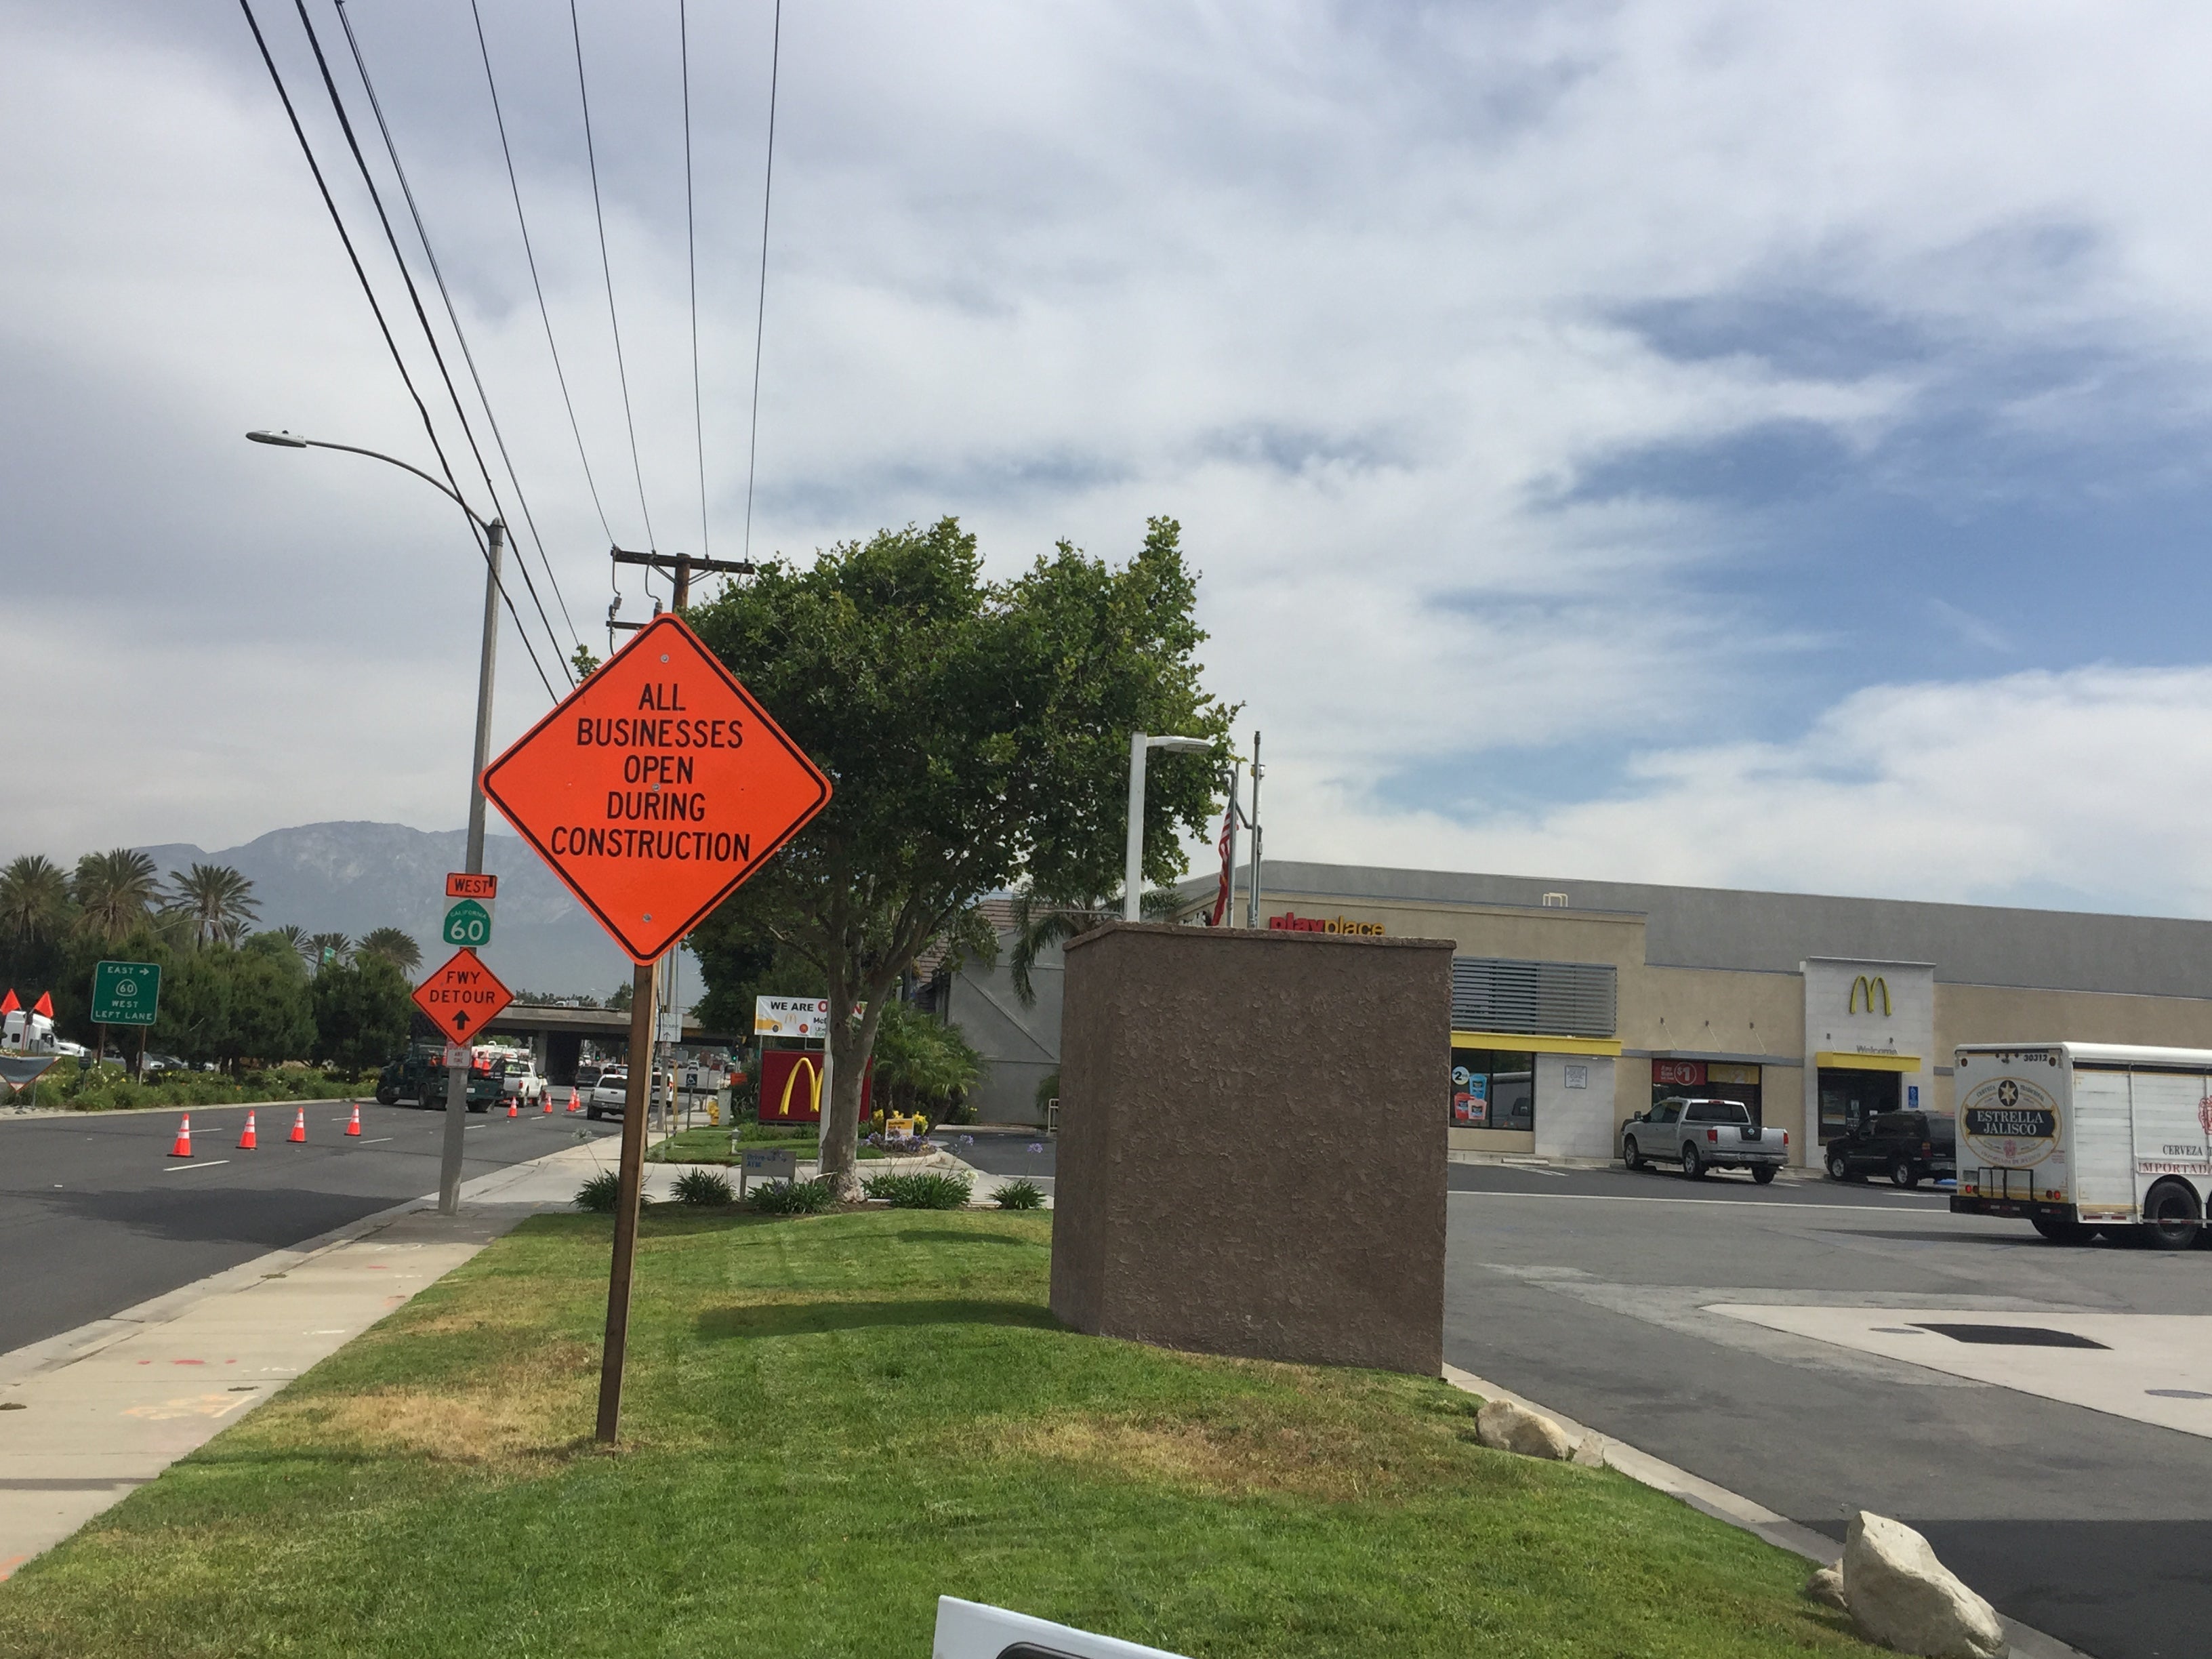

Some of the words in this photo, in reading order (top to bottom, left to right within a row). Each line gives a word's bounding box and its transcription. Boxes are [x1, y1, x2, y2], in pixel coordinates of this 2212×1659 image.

[638, 683, 686, 711] ALL
[577, 718, 743, 748] BUSINESSES
[623, 755, 693, 784] OPEN
[607, 792, 705, 821] DURING
[551, 826, 750, 862] CONSTRUCTION
[455, 878, 489, 893] WEST
[450, 909, 487, 920] CALIFORNIA
[451, 919, 484, 941] 60
[446, 971, 481, 985] FWY
[120, 985, 134, 993] 60
[430, 989, 495, 1004] DETOUR
[771, 1002, 787, 1010] WE
[791, 1002, 814, 1012] ARE
[1856, 1045, 1898, 1055] Welcome
[2024, 1054, 2047, 1062] 30312
[1677, 1067, 1690, 1081] $1
[1977, 1110, 2044, 1124] ESTRELLA
[1983, 1122, 2036, 1135] JALISCO
[2163, 1145, 2203, 1155] CERVEZA
[2138, 1162, 2212, 1174] IMPORTAD
